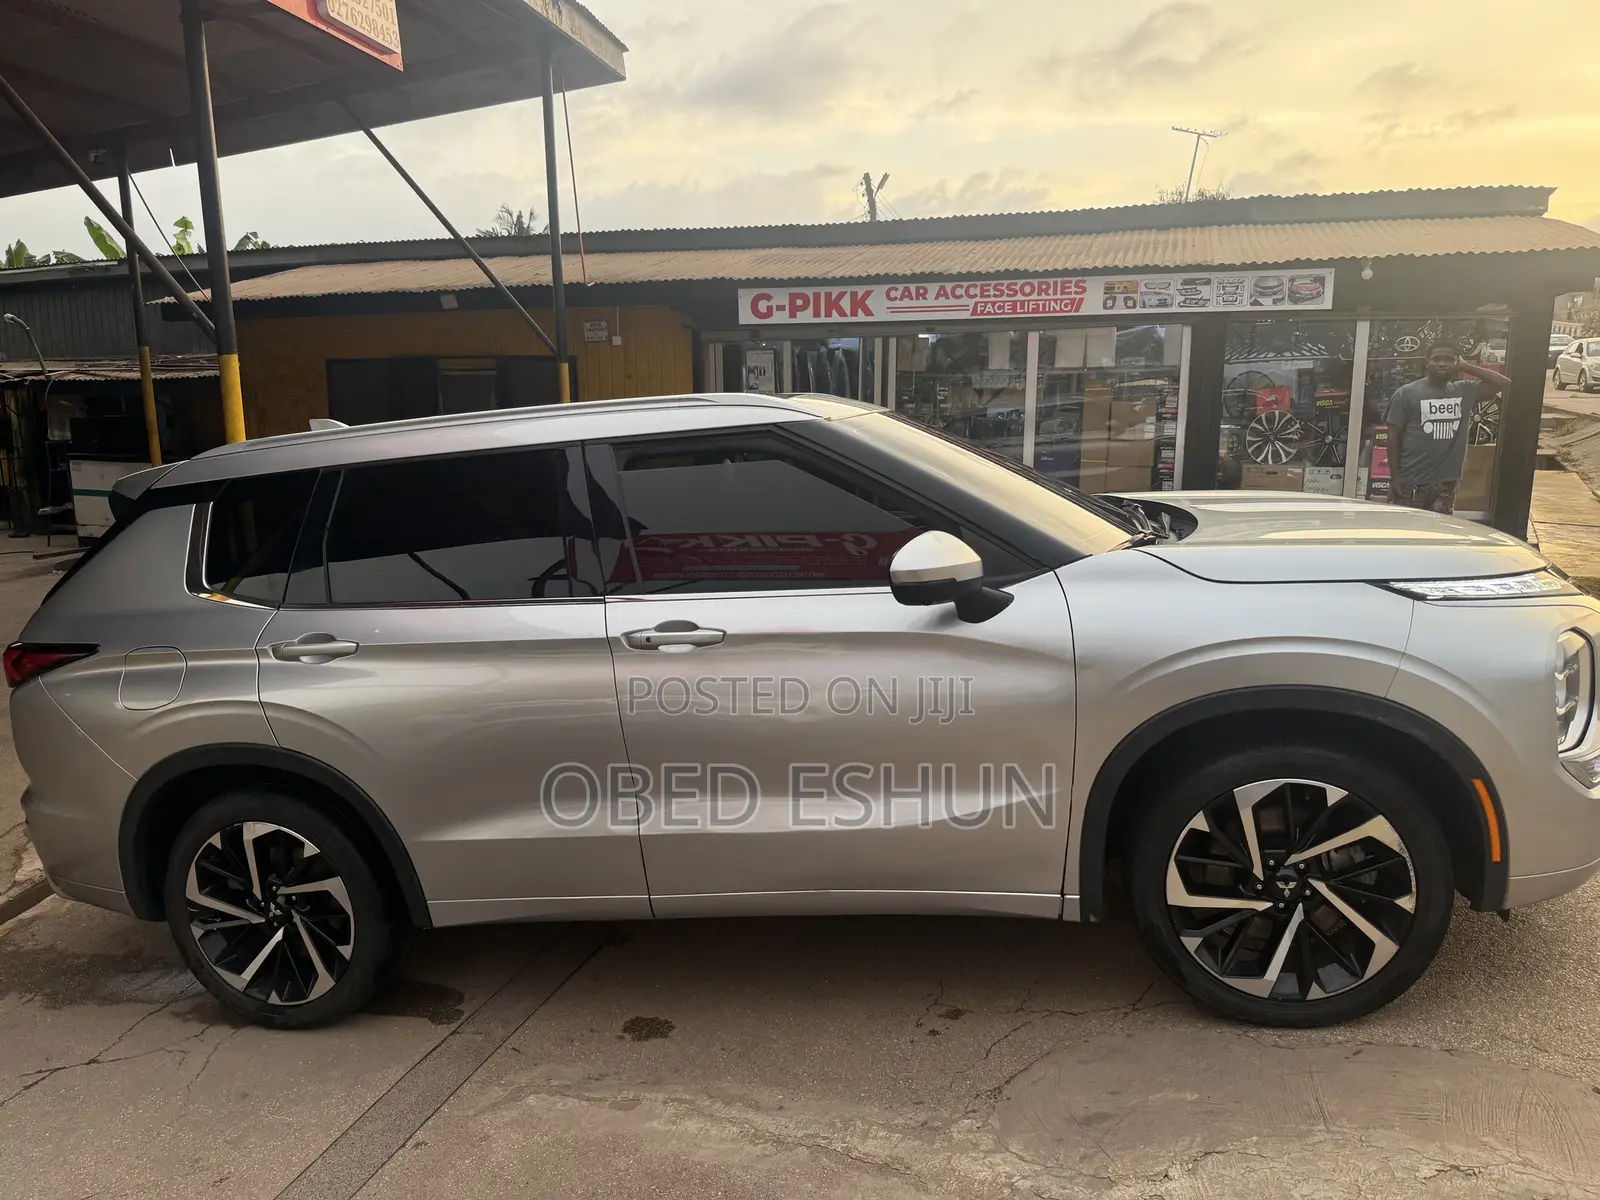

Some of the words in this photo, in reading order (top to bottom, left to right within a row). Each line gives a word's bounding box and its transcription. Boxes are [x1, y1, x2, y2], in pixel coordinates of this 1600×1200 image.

[885, 285, 928, 302] CAR
[934, 279, 1087, 301] ACCESSORIES
[750, 290, 875, 320] G-PIKK
[977, 302, 1012, 314] FACE
[1016, 300, 1072, 313] LIFTING
